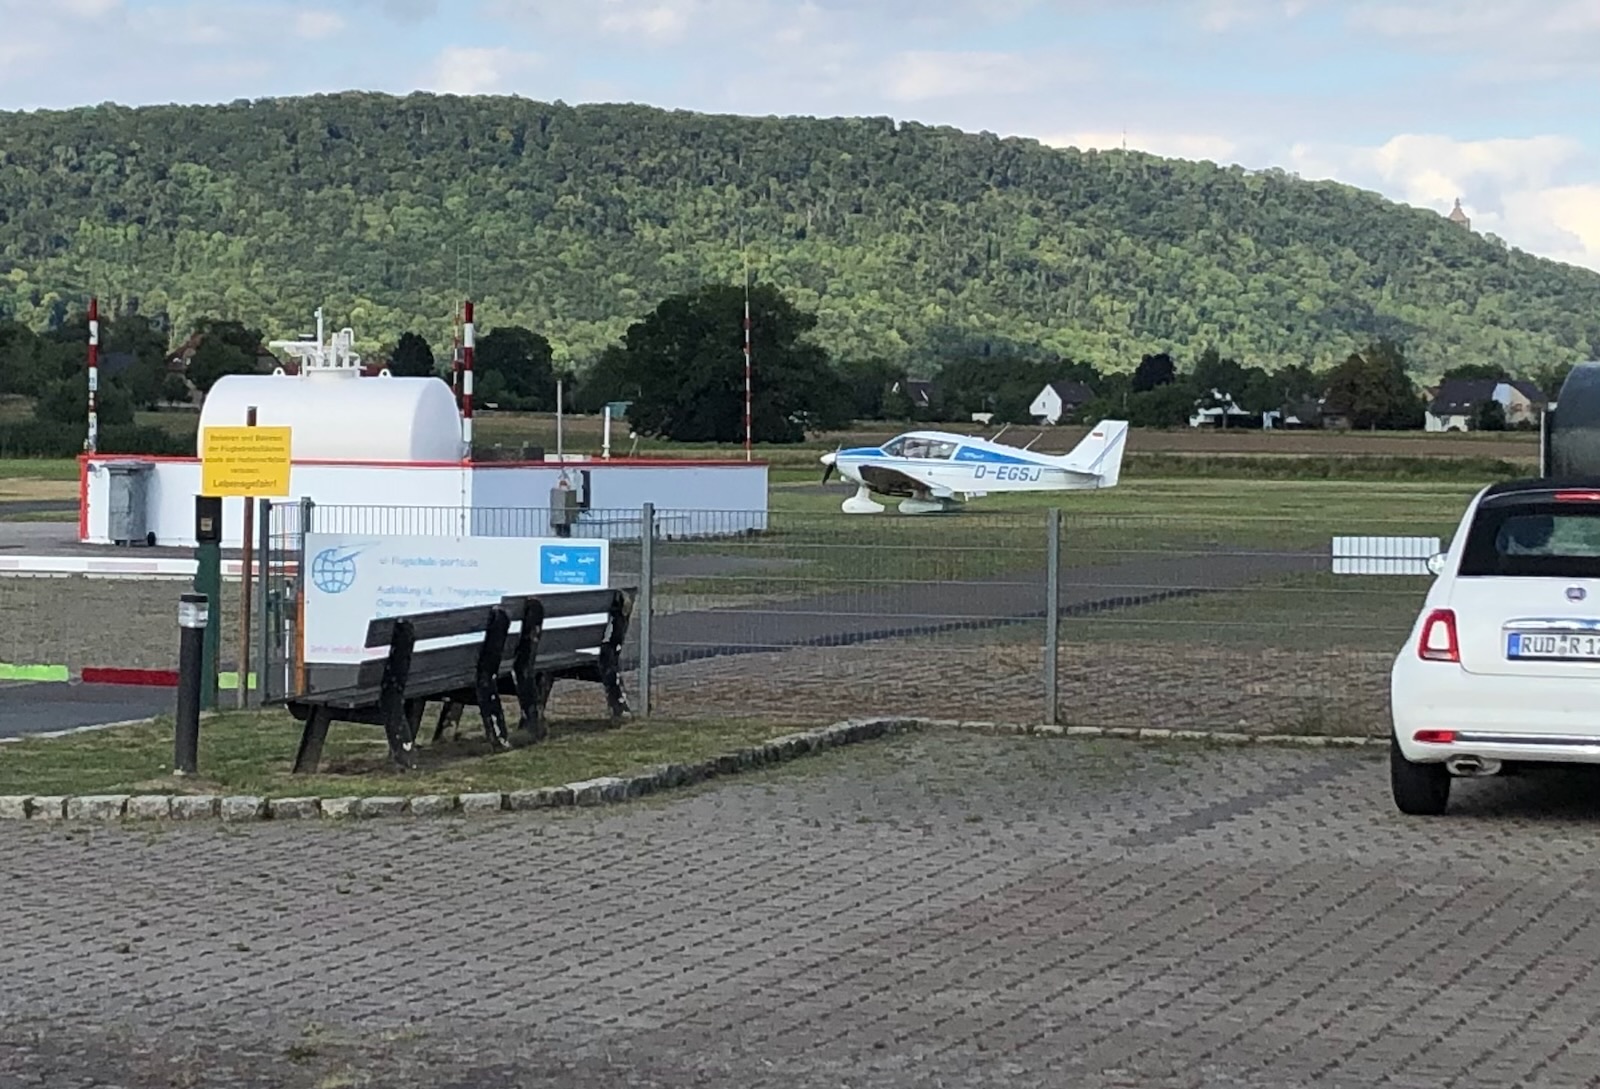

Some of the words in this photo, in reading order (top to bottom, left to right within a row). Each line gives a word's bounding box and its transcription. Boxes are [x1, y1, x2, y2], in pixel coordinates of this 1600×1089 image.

[974, 464, 1042, 482] D-EGSJ
[1521, 636, 1556, 654] RUD
[1569, 637, 1580, 654] R
